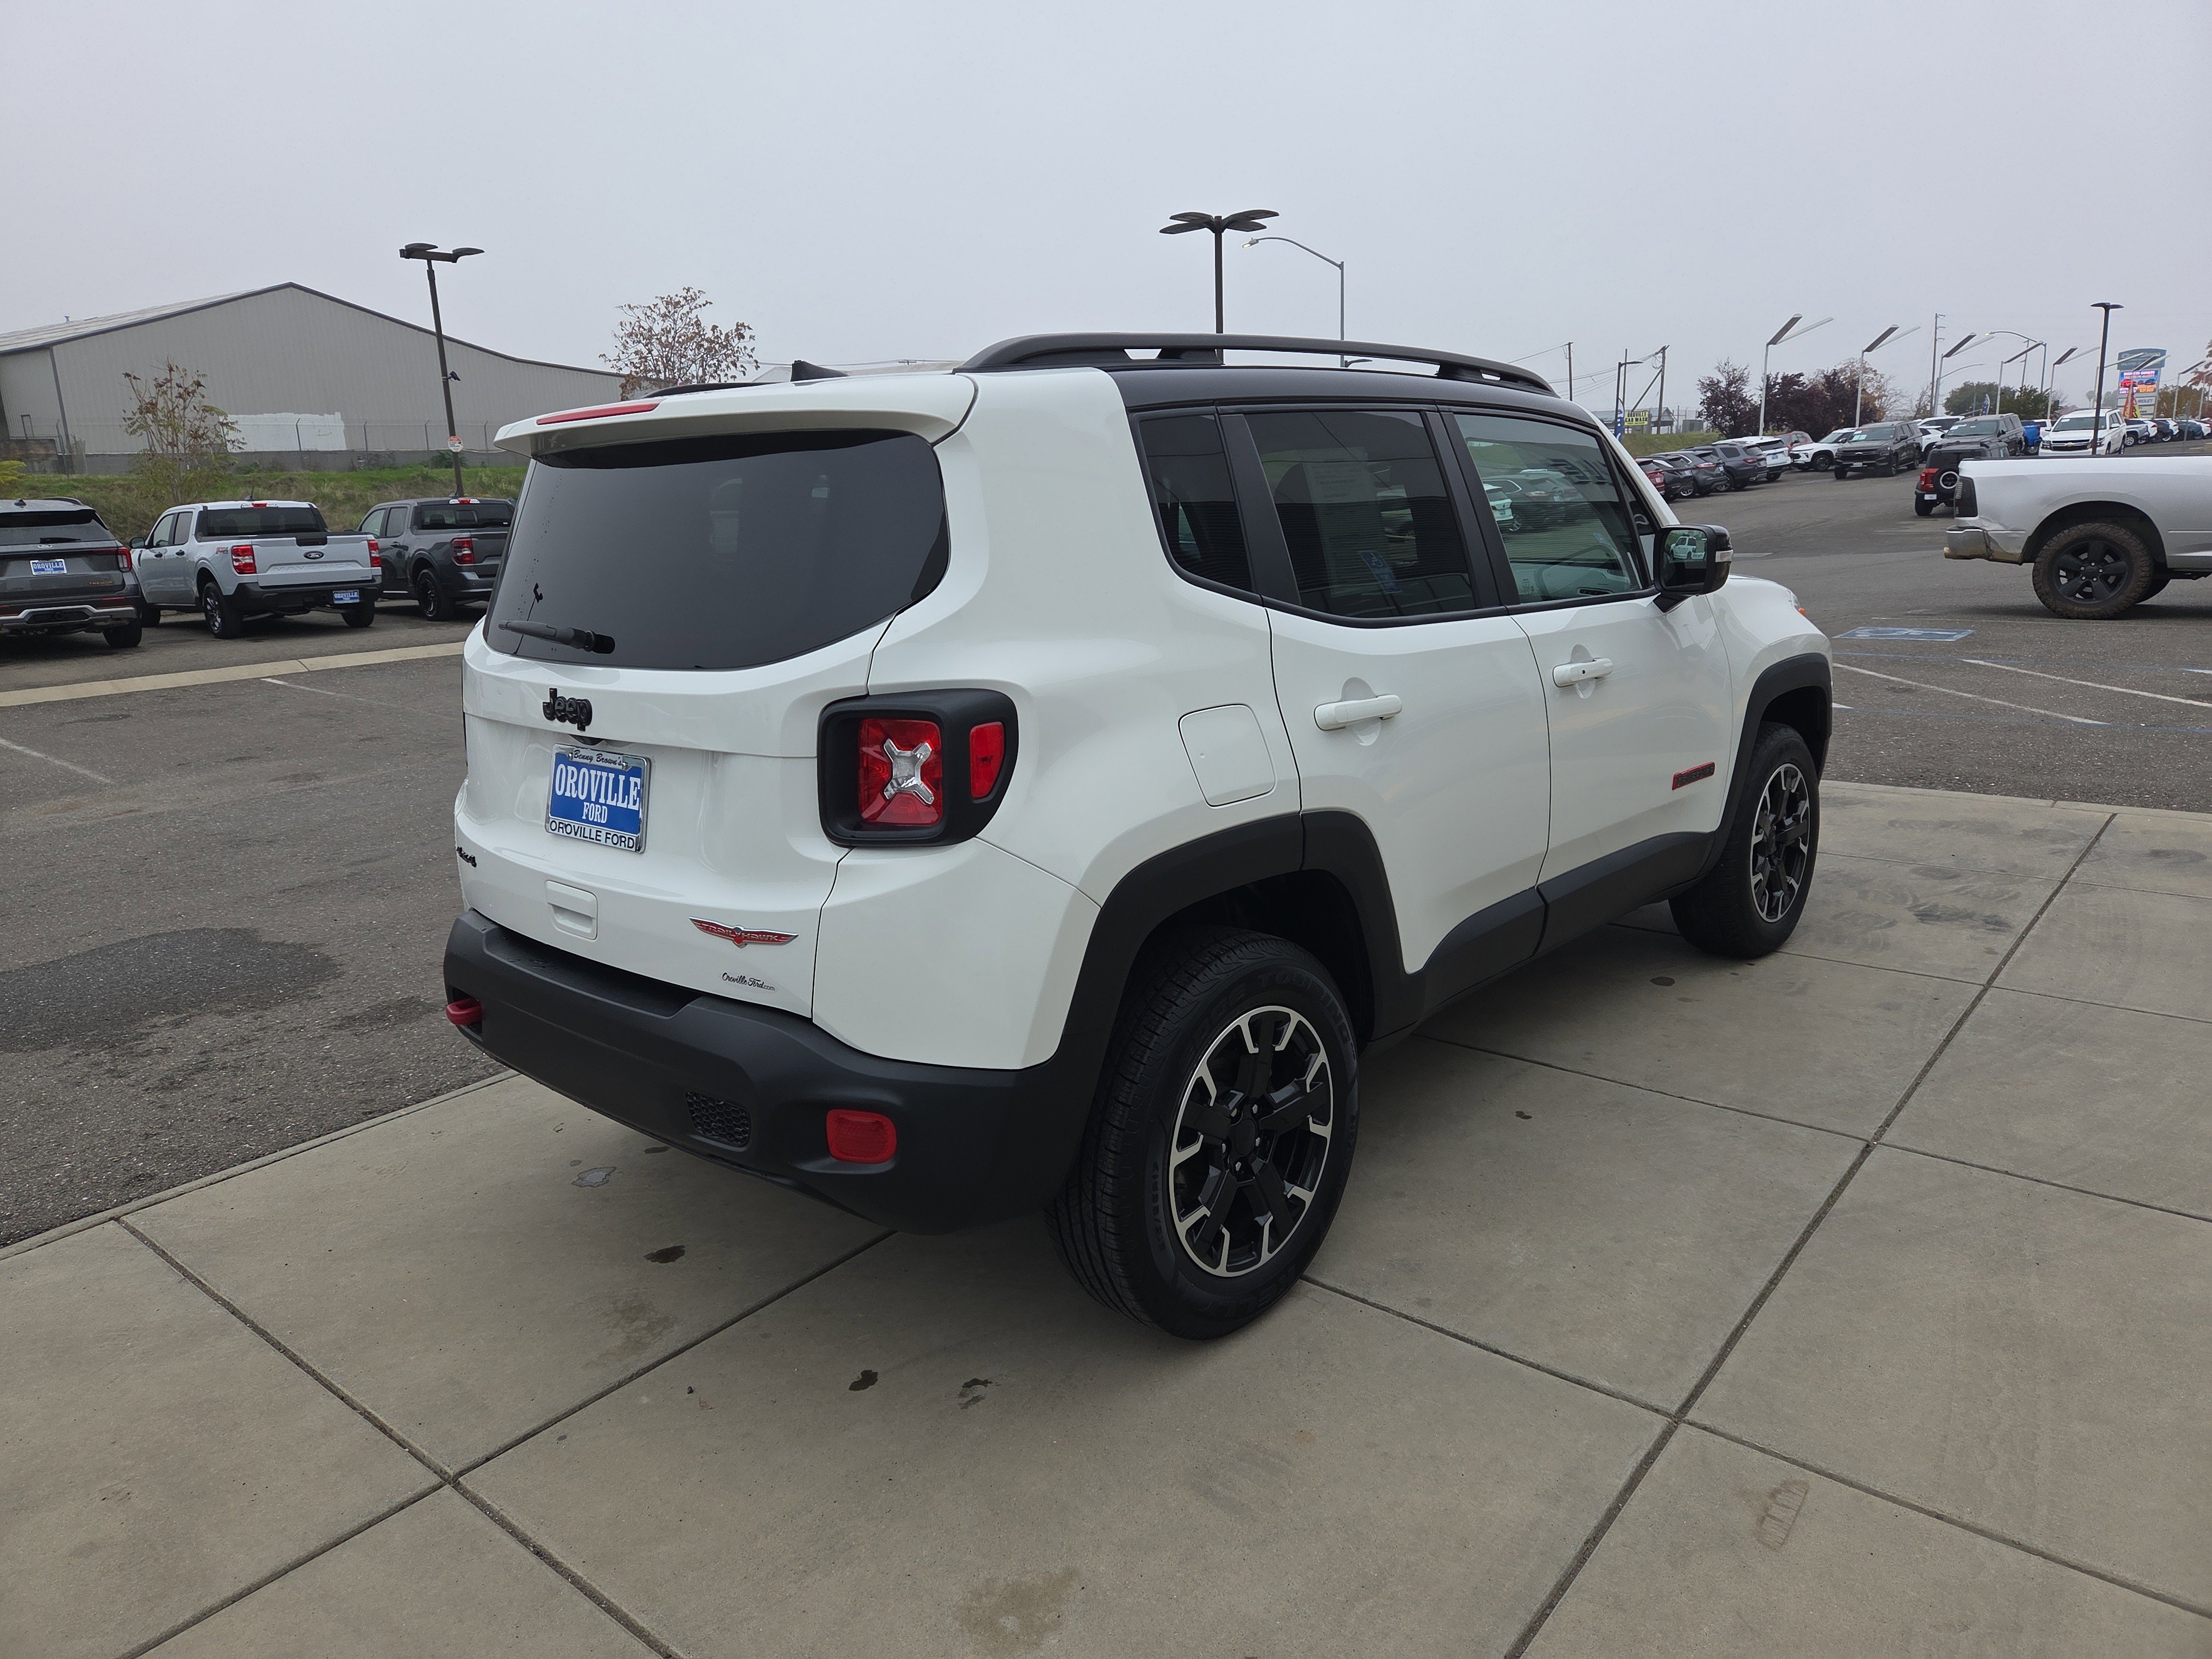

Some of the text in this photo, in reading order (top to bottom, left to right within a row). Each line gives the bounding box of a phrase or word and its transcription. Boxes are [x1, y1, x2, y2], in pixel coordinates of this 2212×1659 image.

[543, 688, 593, 731] Jeep
[574, 749, 623, 766] Benny Brown's
[555, 763, 641, 811] OROVILLE
[582, 802, 607, 824] FORD
[550, 820, 635, 849] OROVILLE FORD
